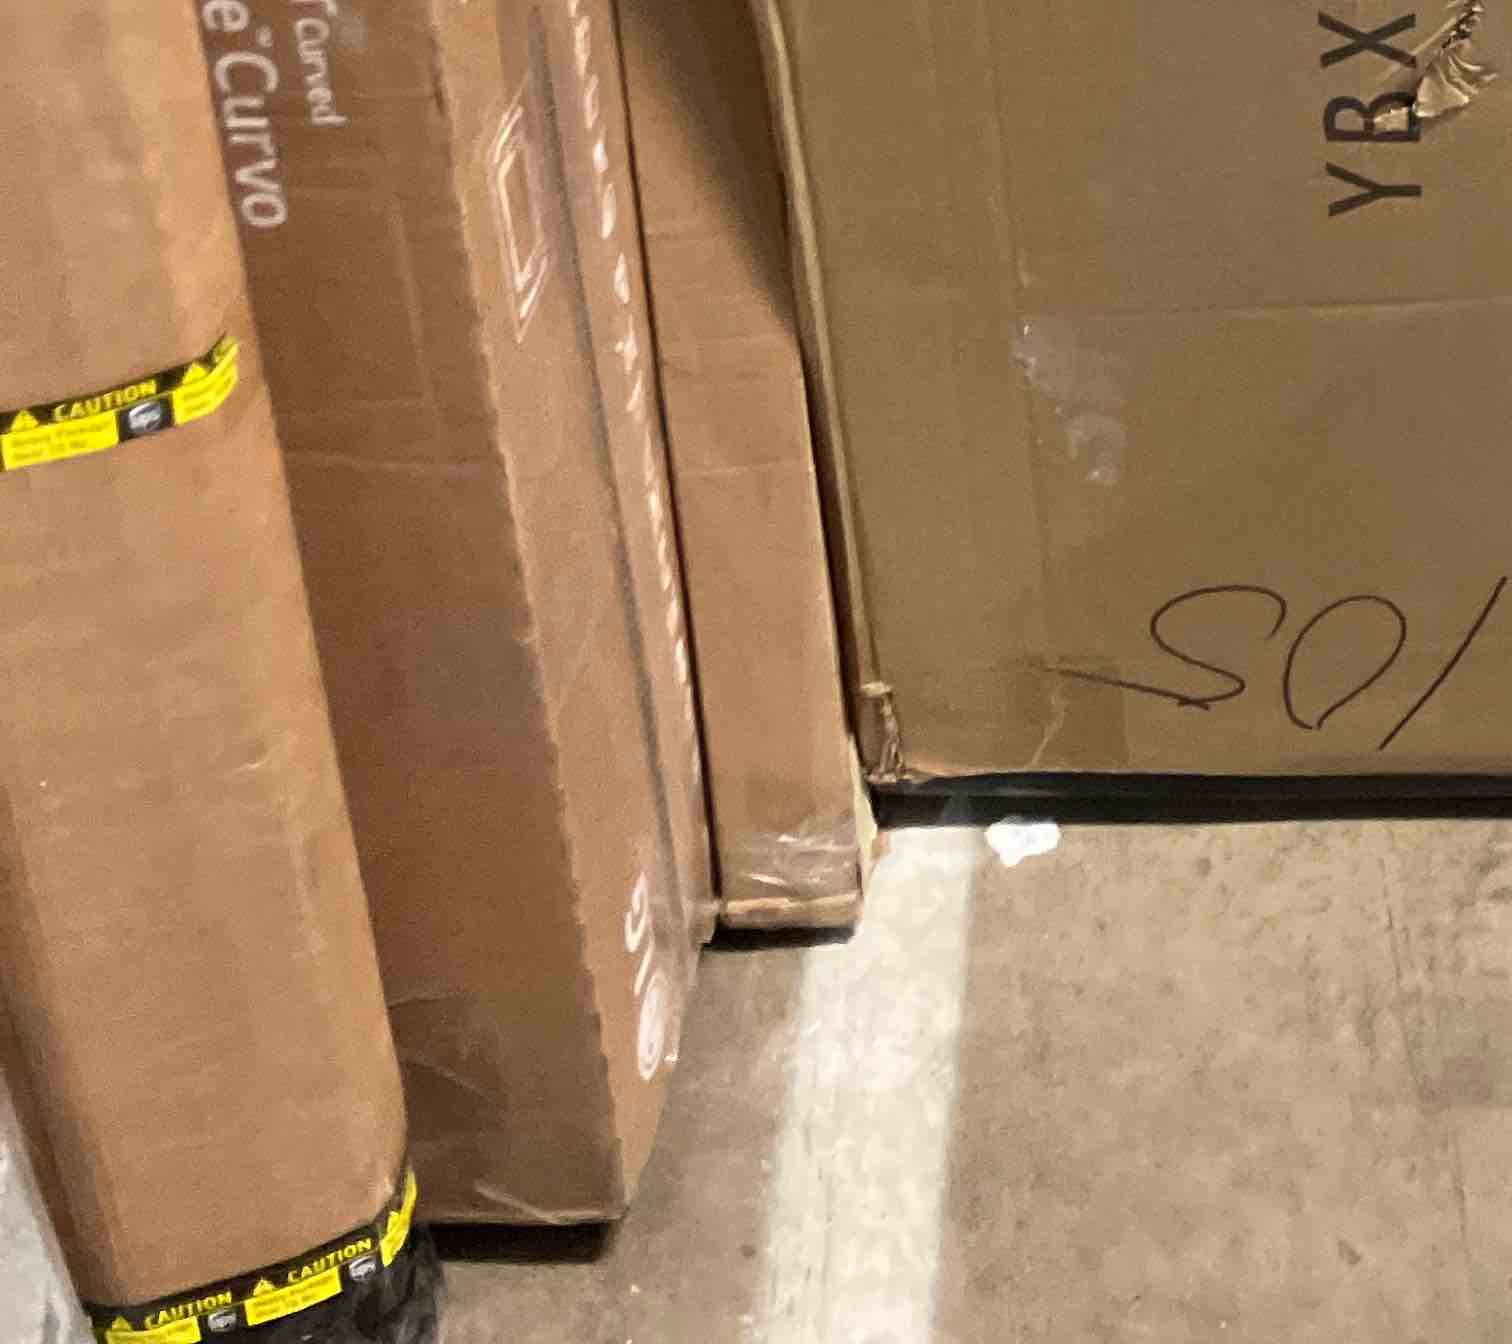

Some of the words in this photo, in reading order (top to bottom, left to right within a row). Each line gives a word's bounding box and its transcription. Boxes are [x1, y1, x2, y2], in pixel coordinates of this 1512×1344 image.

[213, 51, 289, 229] Curvo
[52, 379, 157, 422] CAUTION
[287, 1238, 372, 1284] CAUTION
[144, 1291, 233, 1330] CAUTION
